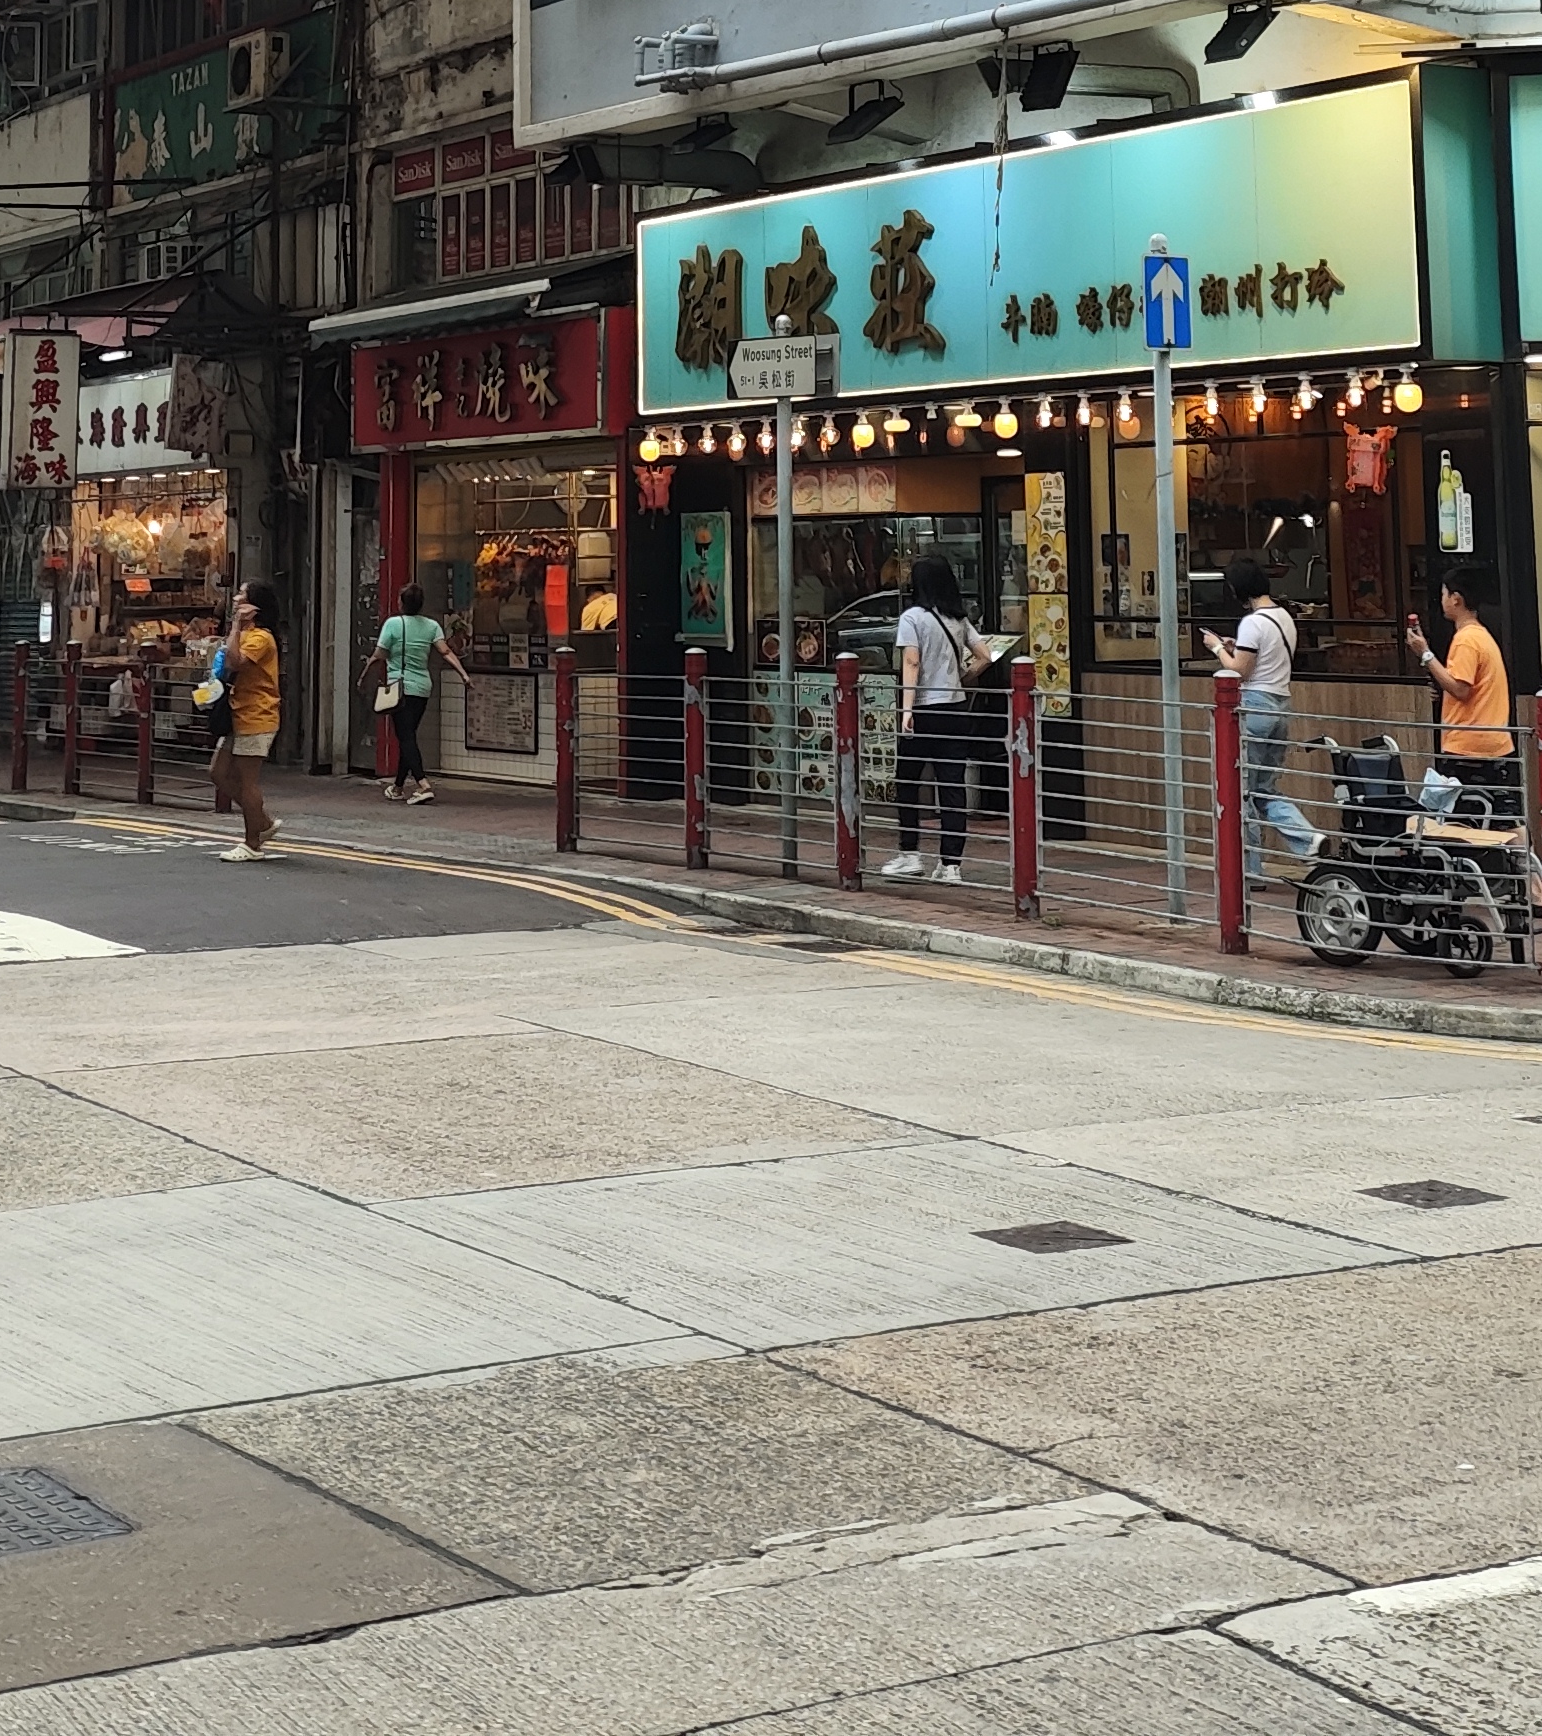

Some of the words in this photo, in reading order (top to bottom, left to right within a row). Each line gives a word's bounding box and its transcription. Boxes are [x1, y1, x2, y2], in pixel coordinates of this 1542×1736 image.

[171, 62, 209, 97] TAZAN
[398, 161, 433, 183] SanDisk
[446, 149, 483, 172] SanDisk
[674, 209, 946, 373] 潮味莊
[742, 347, 782, 363] Woosung
[784, 344, 813, 360] Street
[758, 370, 795, 390] 吳松街
[29, 339, 61, 452] 盈興隆
[14, 453, 72, 485] 海味
